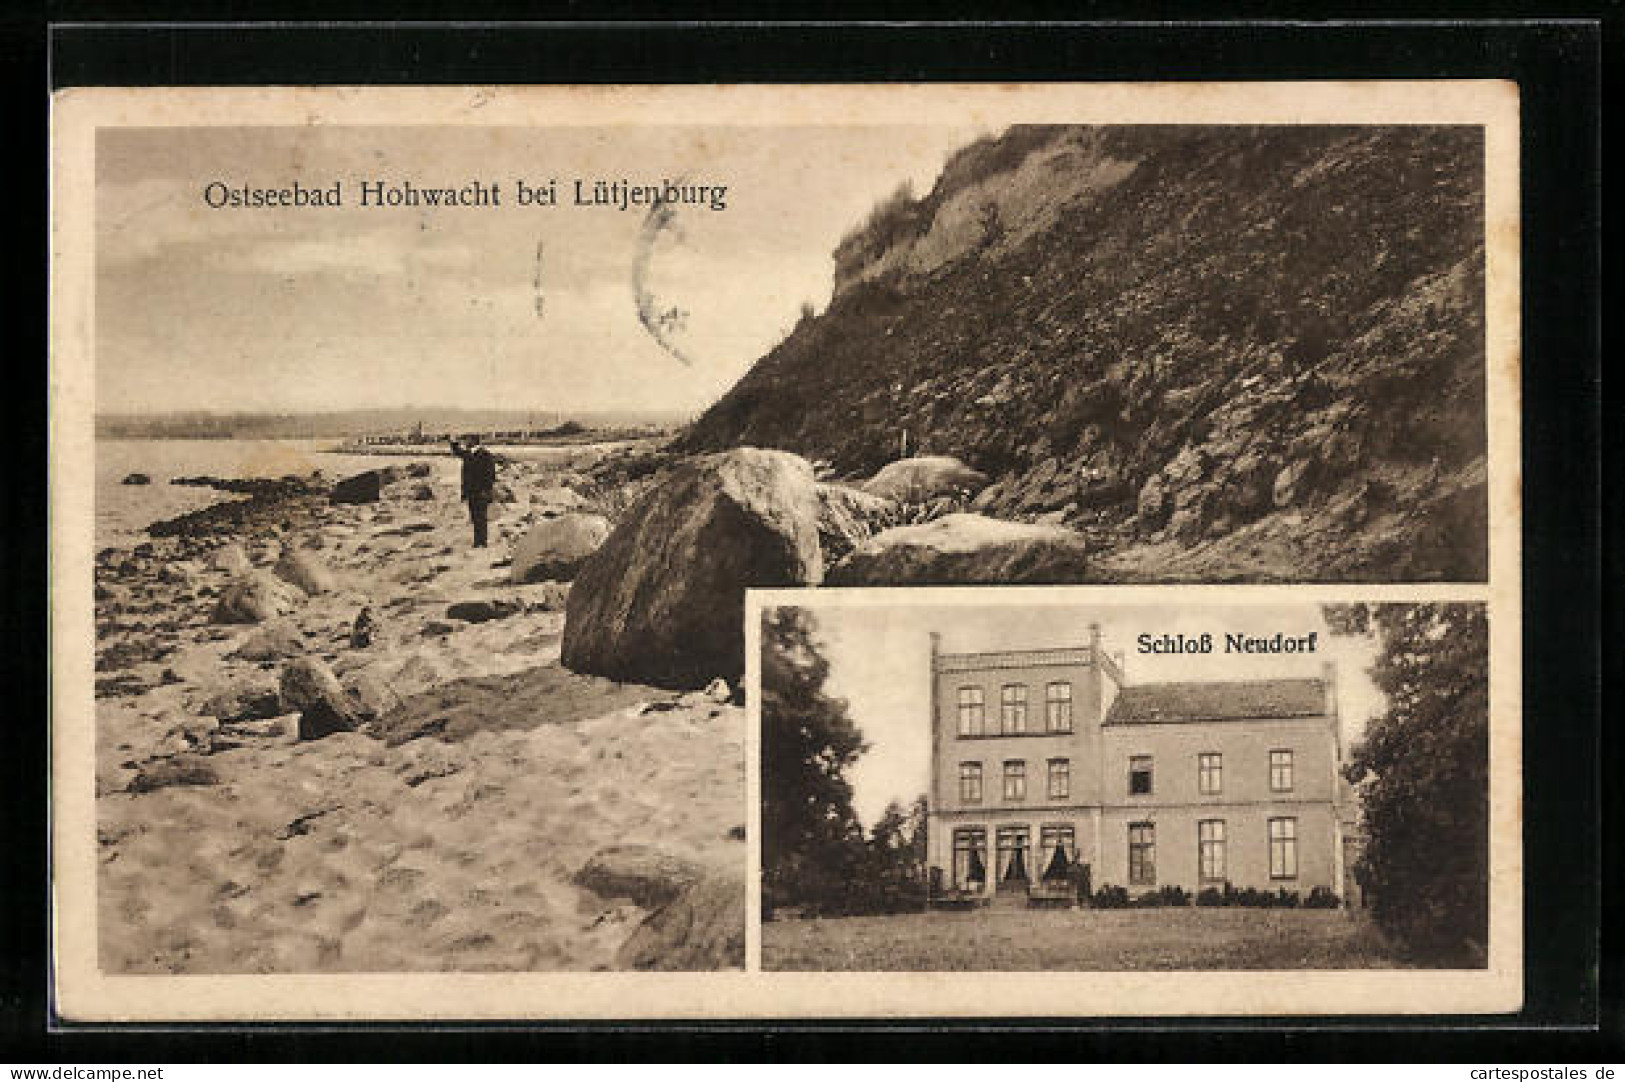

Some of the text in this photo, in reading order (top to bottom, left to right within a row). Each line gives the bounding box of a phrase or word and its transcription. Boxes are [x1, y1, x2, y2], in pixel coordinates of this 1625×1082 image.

[203, 178, 728, 211] Ostseebad Hohwacht bei Lütjenburg
[1137, 631, 1318, 654] Schloß Neudorf
